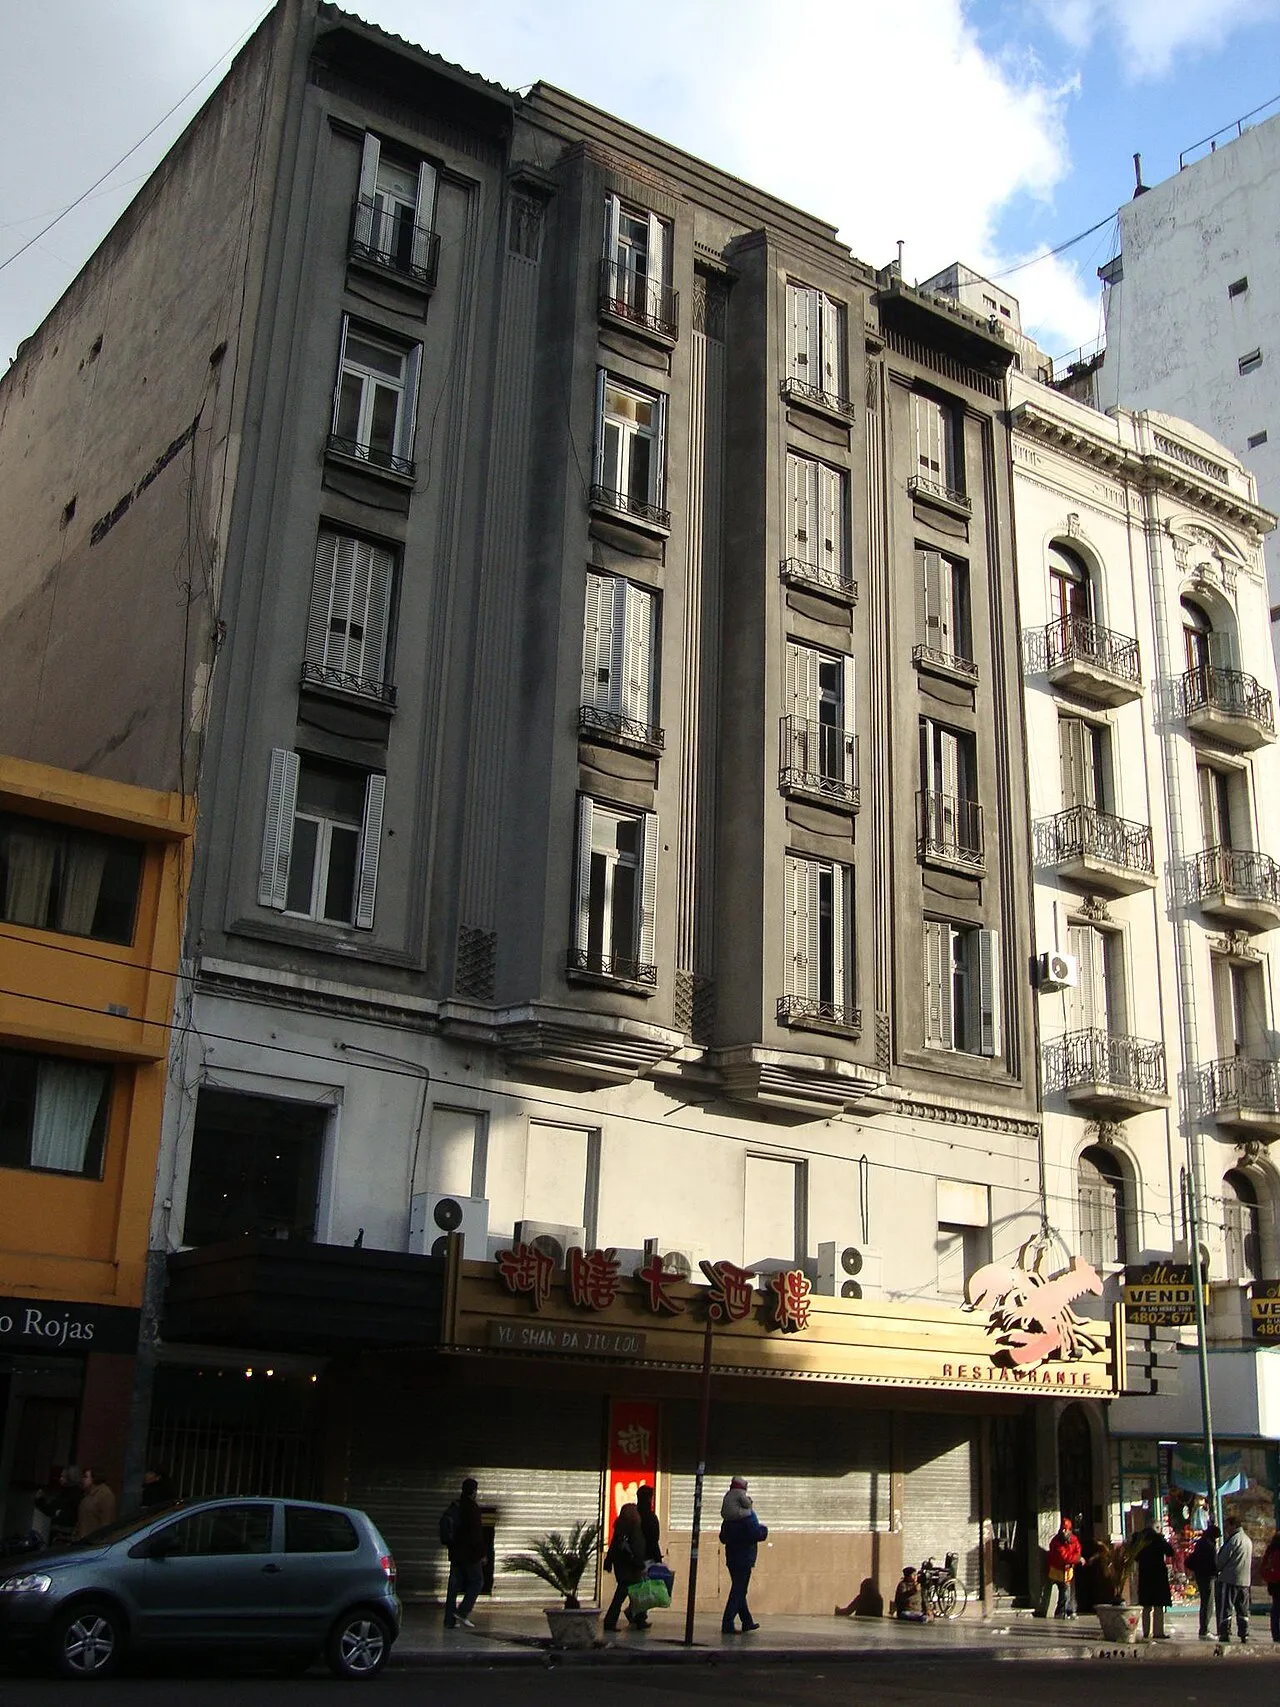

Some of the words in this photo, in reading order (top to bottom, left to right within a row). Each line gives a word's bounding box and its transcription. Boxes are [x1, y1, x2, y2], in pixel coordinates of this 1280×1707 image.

[22, 1308, 95, 1346] Rojas
[1129, 1311, 1198, 1325] 4802-671
[521, 1328, 556, 1346] SHAN
[561, 1332, 579, 1348] DA
[584, 1333, 610, 1351] JIU
[614, 1336, 640, 1353] LOU
[943, 1363, 1091, 1387] RESTAURANTE
